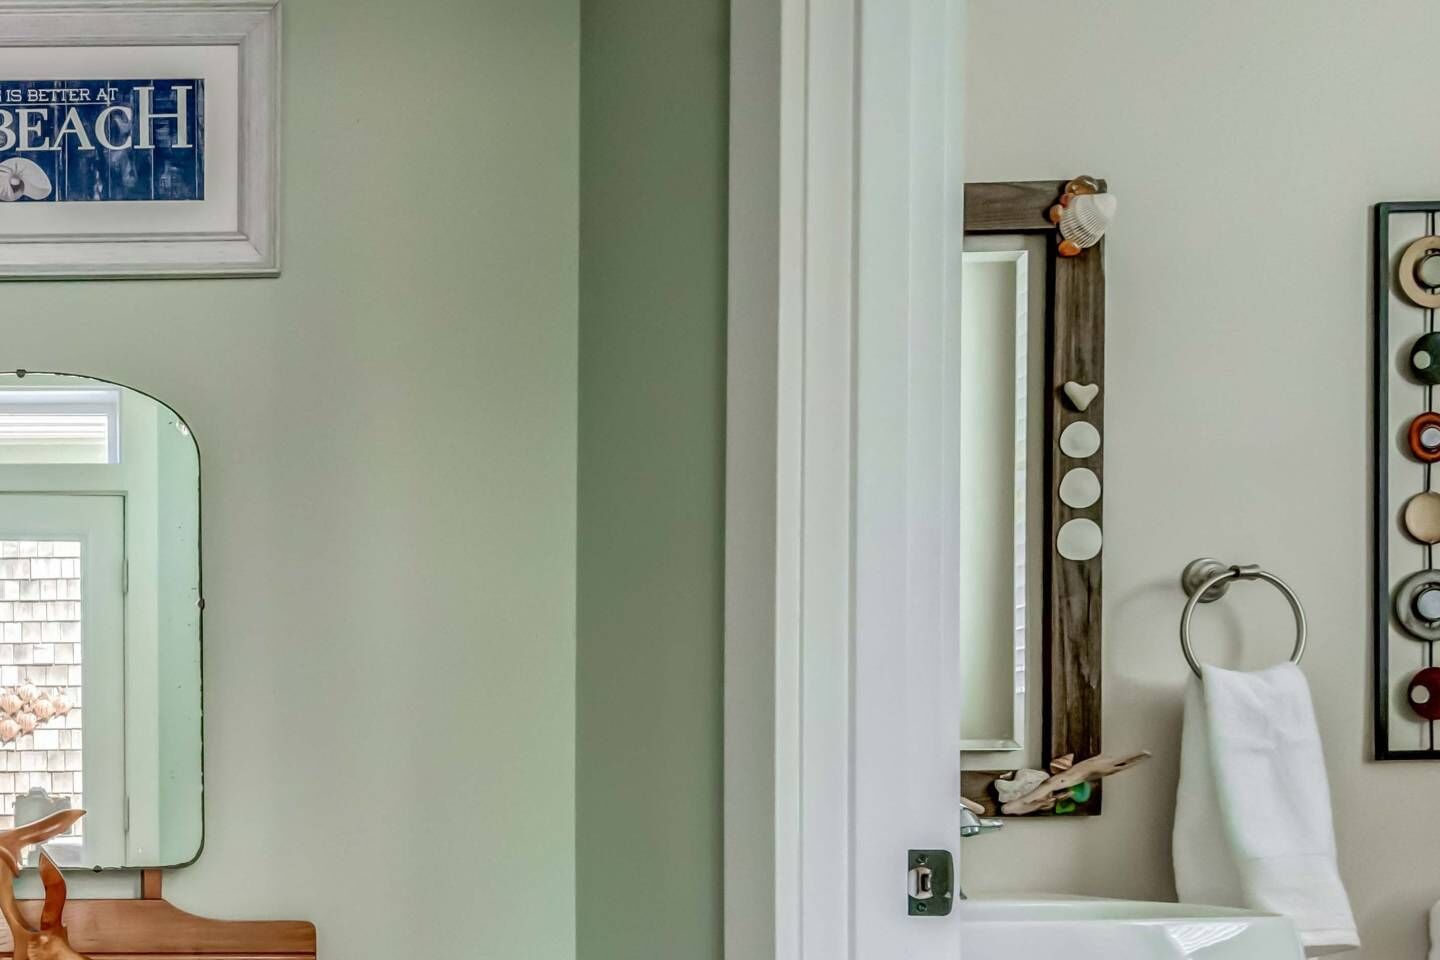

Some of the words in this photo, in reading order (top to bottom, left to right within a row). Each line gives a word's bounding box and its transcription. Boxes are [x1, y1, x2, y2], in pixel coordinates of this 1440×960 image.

[6, 88, 22, 102] IS
[27, 87, 91, 102] BETTER
[95, 86, 118, 101] AT
